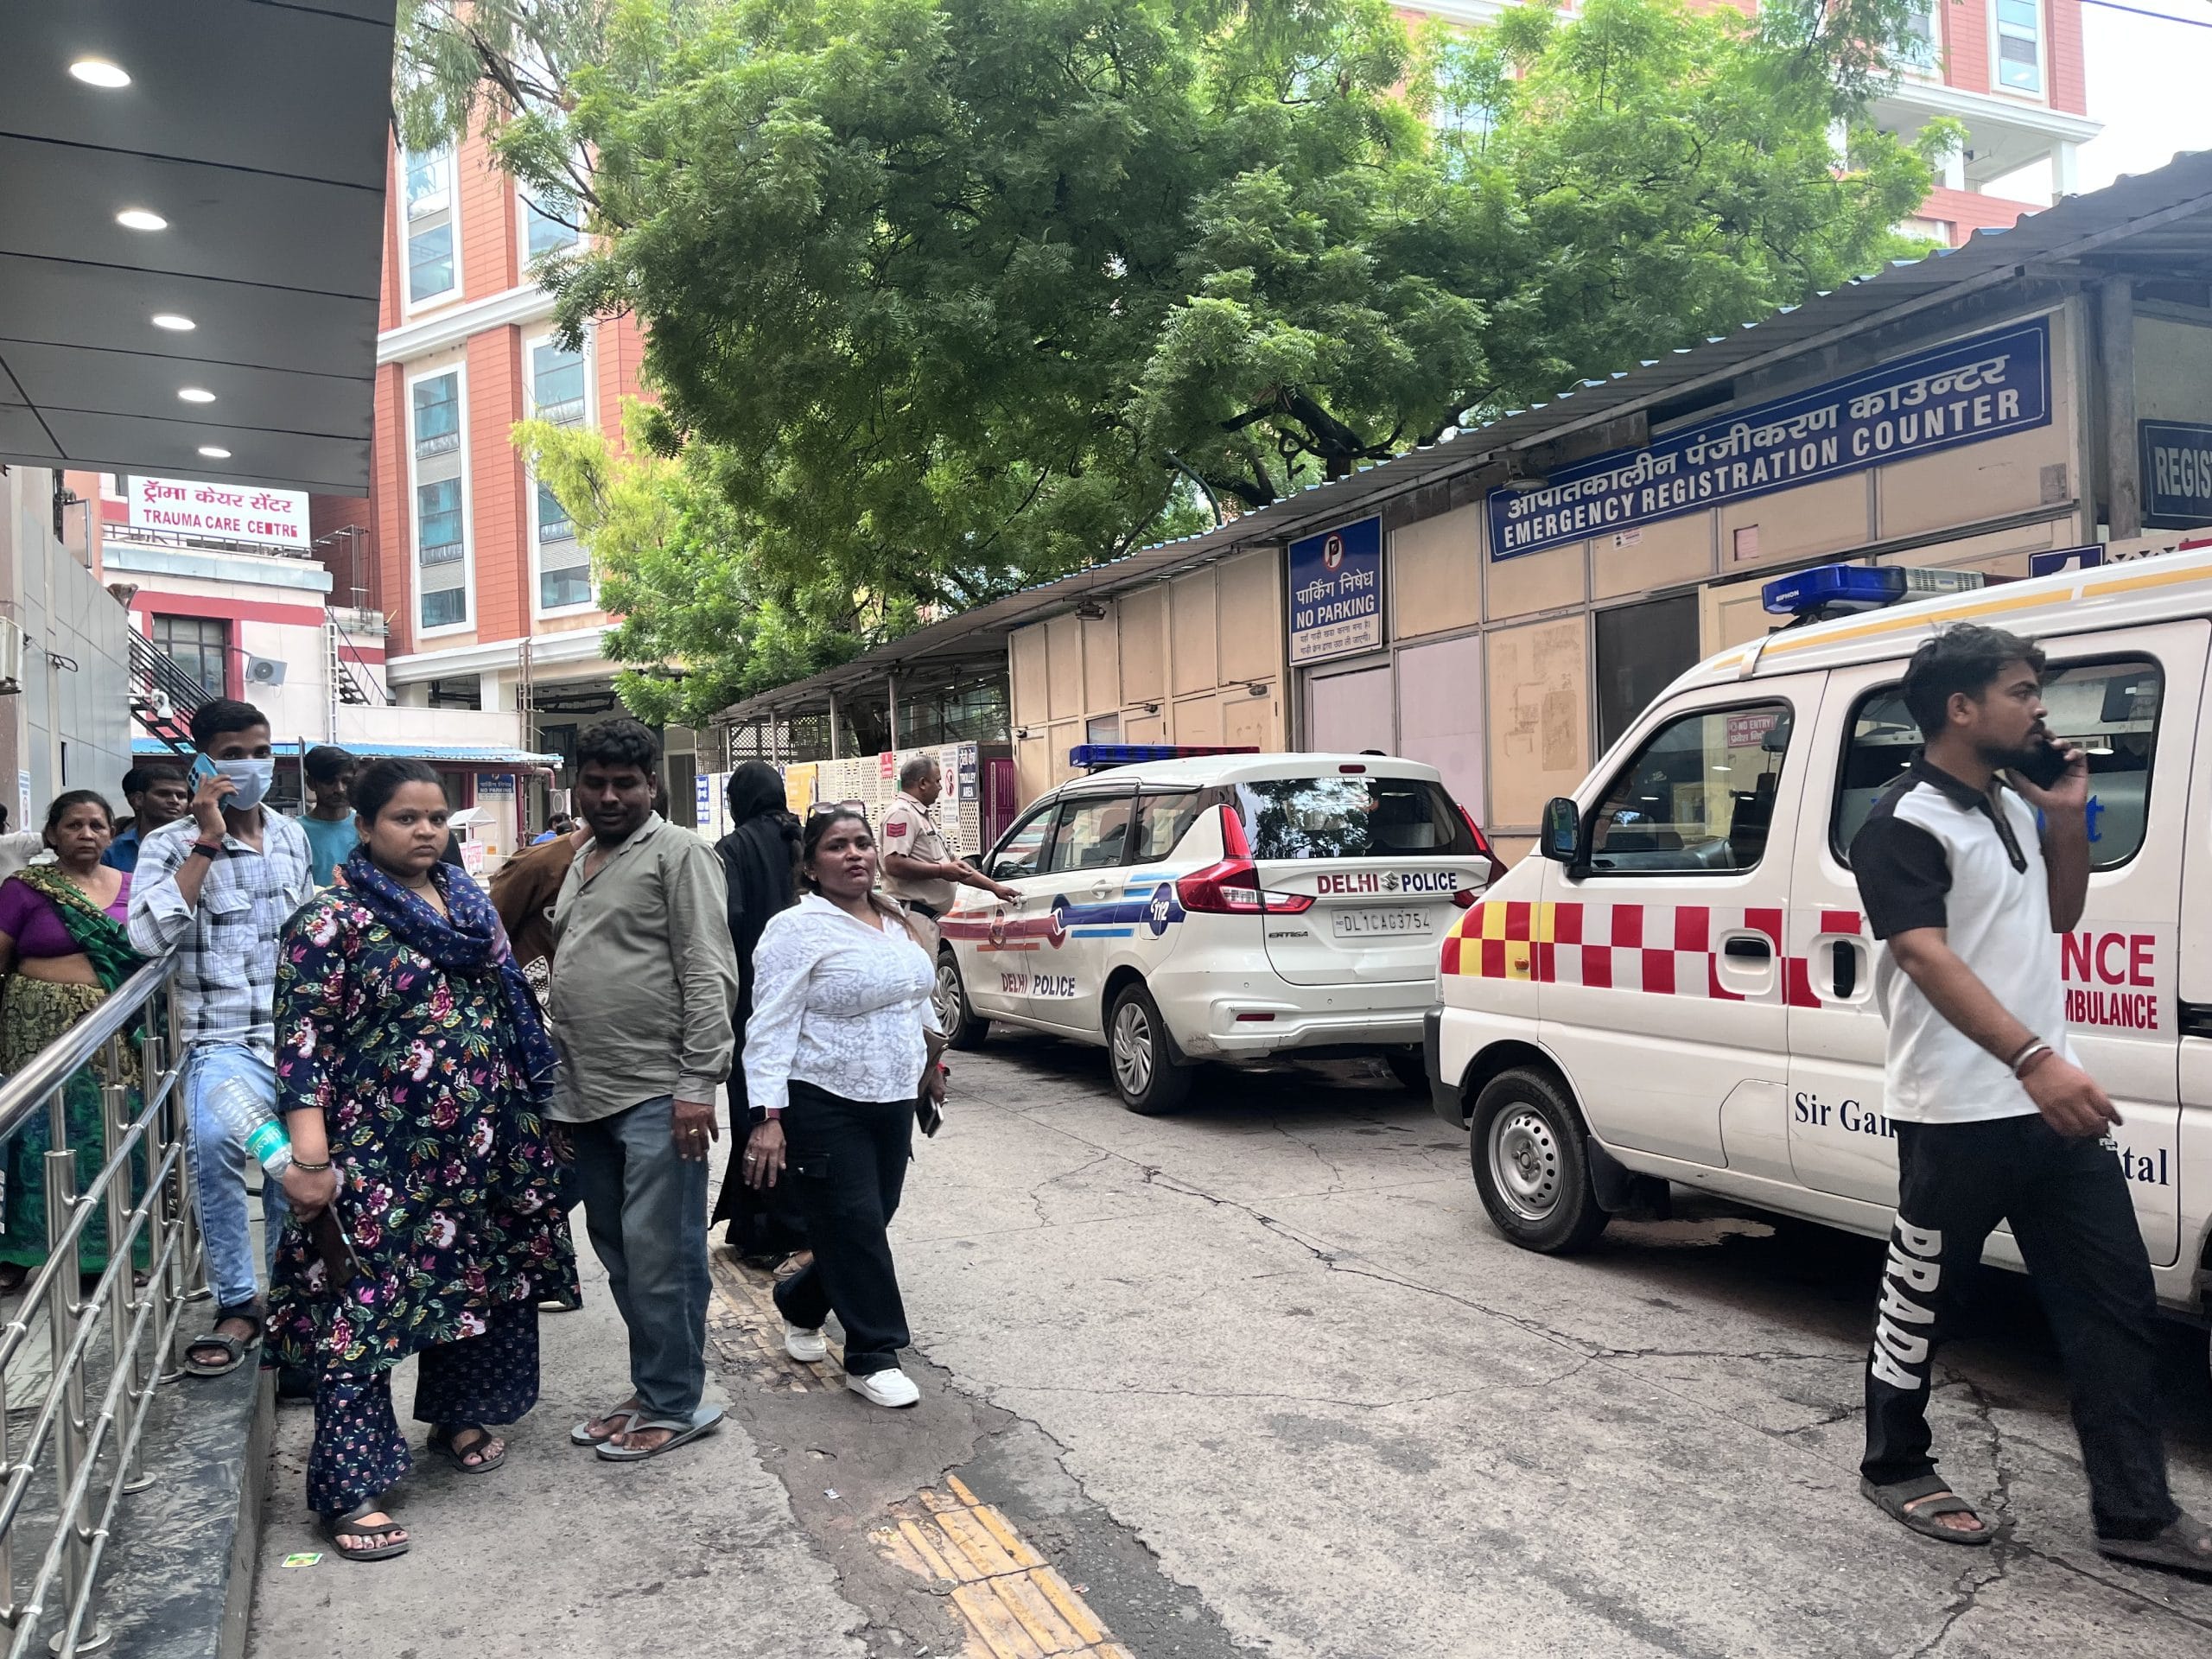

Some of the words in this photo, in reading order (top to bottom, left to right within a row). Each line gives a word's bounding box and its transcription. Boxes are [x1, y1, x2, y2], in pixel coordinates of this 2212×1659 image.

[1508, 452, 1678, 518] आपातकालीन
[1685, 404, 1840, 466] पंजीकरण
[1848, 354, 2011, 420] काउन्टर
[1504, 493, 1636, 549] EMERGENCY
[1642, 436, 1839, 513] REGISTRATION
[1853, 389, 2020, 457] COUNTER
[2154, 447, 2212, 499] REGIS
[194, 486, 245, 508] केयर
[250, 493, 294, 513] सेंटर
[143, 509, 201, 528] TRAUMA
[206, 516, 240, 532] CARE
[248, 520, 298, 538] CETRE
[1339, 568, 1375, 595] निषेध
[1297, 609, 1314, 630] NO
[1318, 594, 1375, 625] PARKING
[1750, 719, 1771, 729] ENTRY
[1317, 874, 1379, 894] DELHI
[1402, 872, 1458, 893] POLICE
[1001, 972, 1028, 995] DELHI
[1033, 975, 1076, 997] POLICE
[2065, 988, 2158, 1030] BULANCE
[1795, 1091, 1832, 1127] Sir
[1840, 1099, 1896, 1139] Gan
[1872, 1211, 1942, 1390] PRADA
